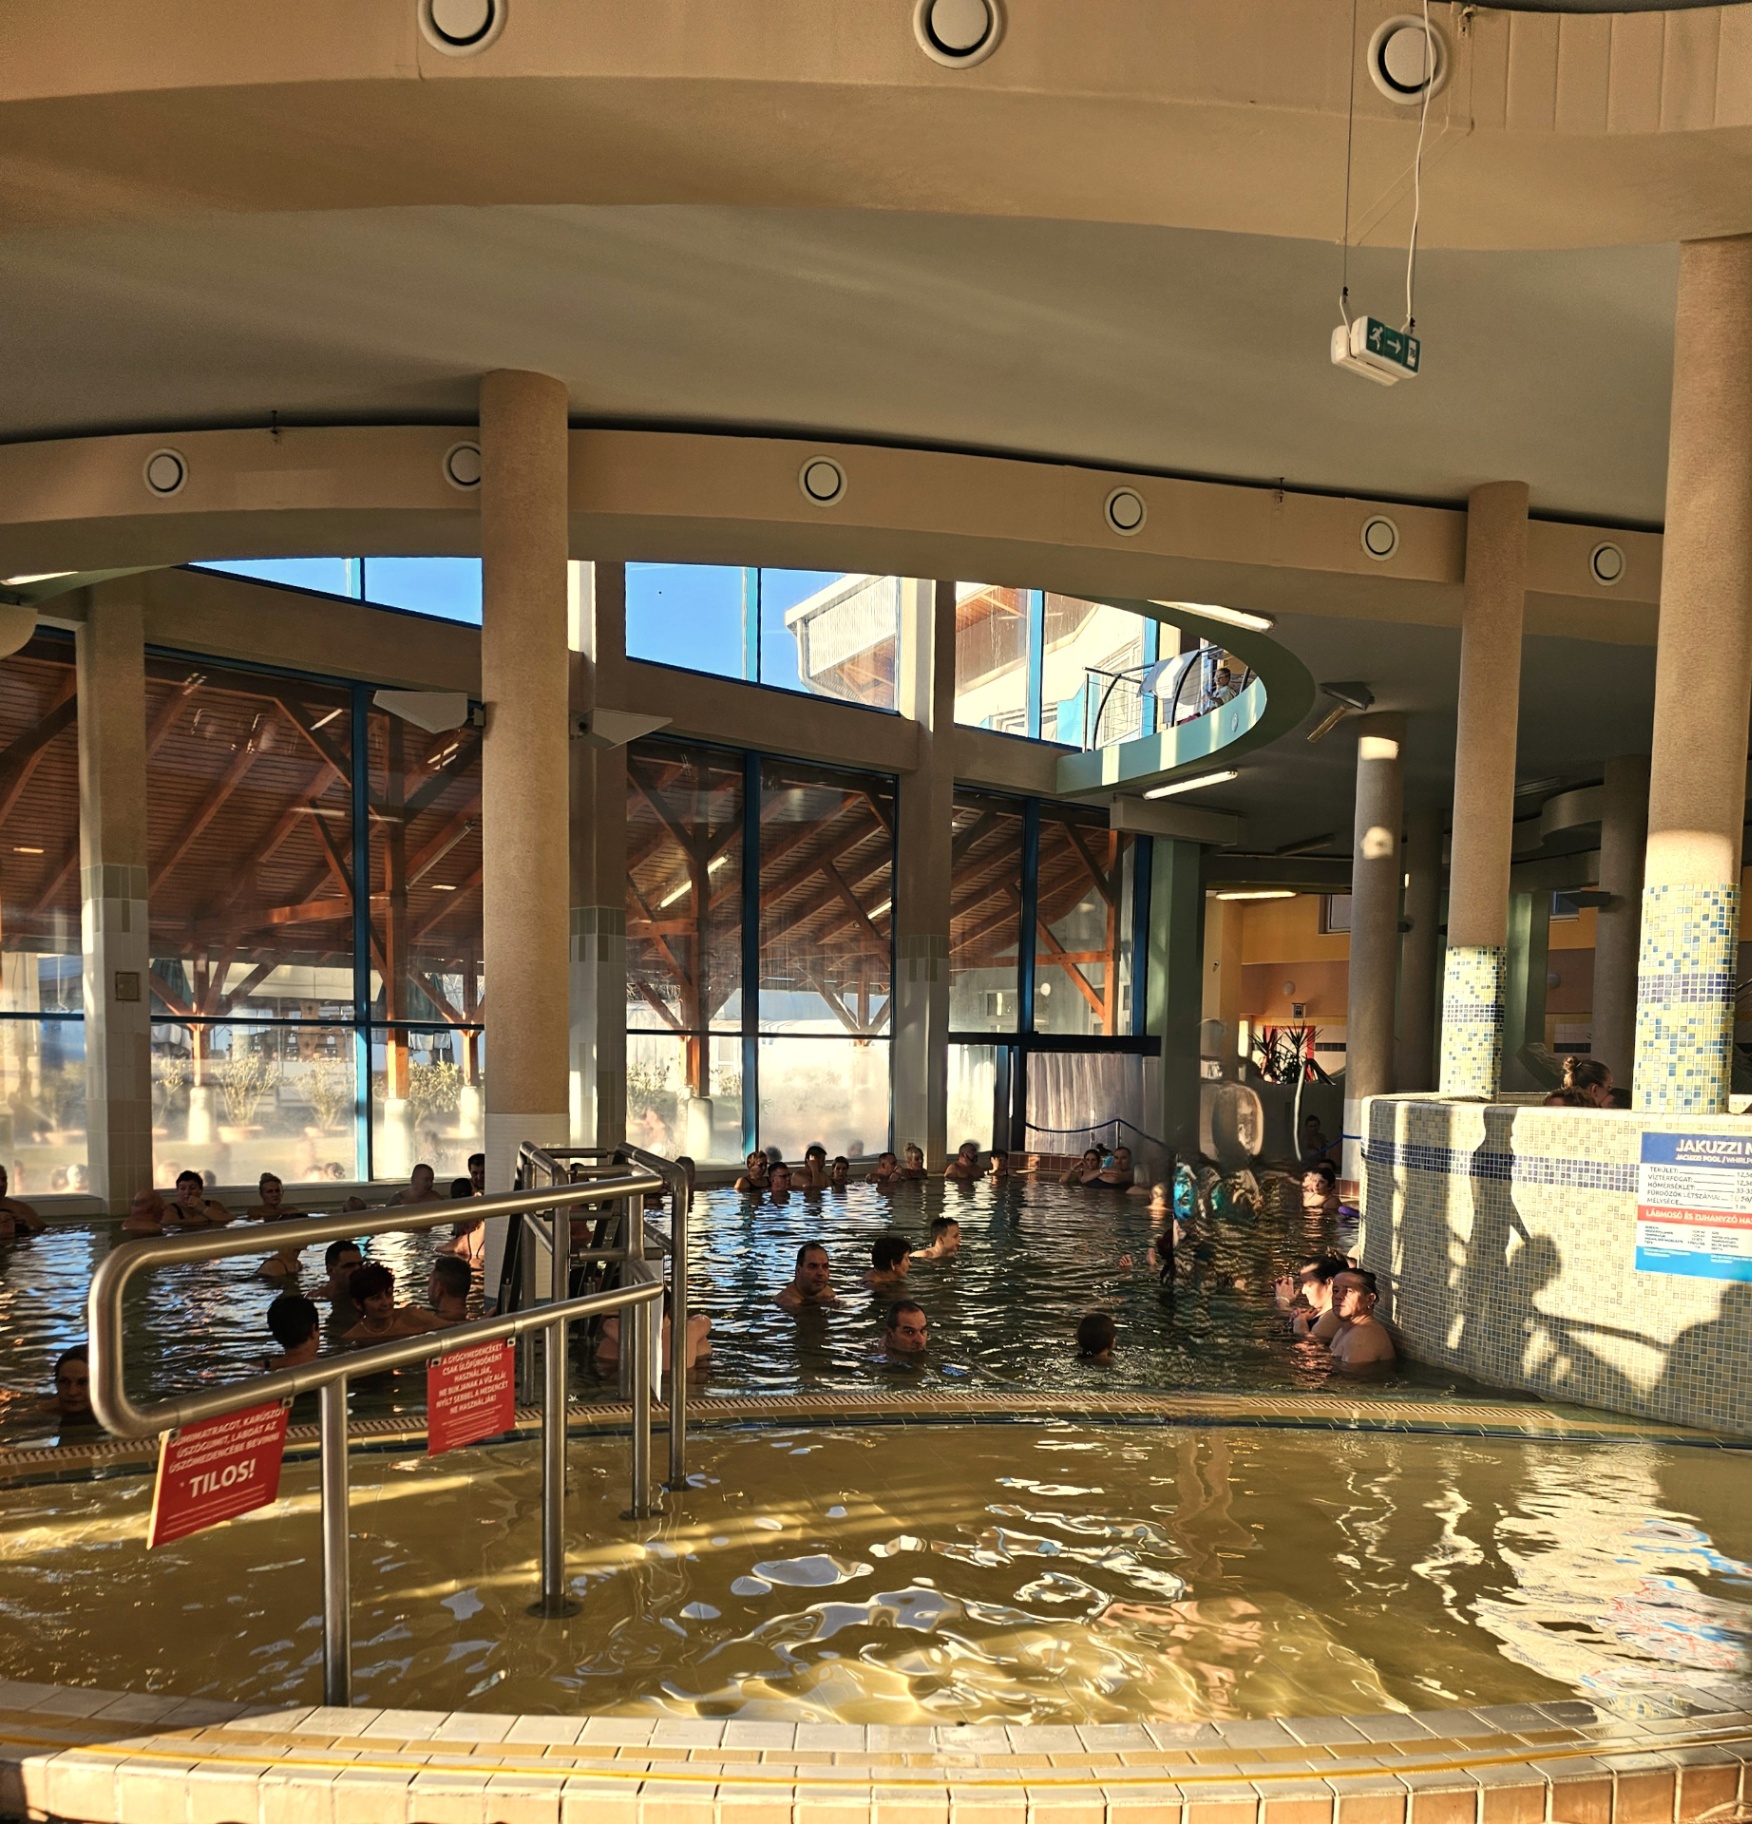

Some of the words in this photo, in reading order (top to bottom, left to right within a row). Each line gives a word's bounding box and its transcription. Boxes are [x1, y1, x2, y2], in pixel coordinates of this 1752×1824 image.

[1676, 1139, 1742, 1154] JAKUZZI
[442, 1364, 458, 1376] CSAK
[264, 1421, 277, 1433] AZ
[189, 1458, 256, 1498] TILOS!
